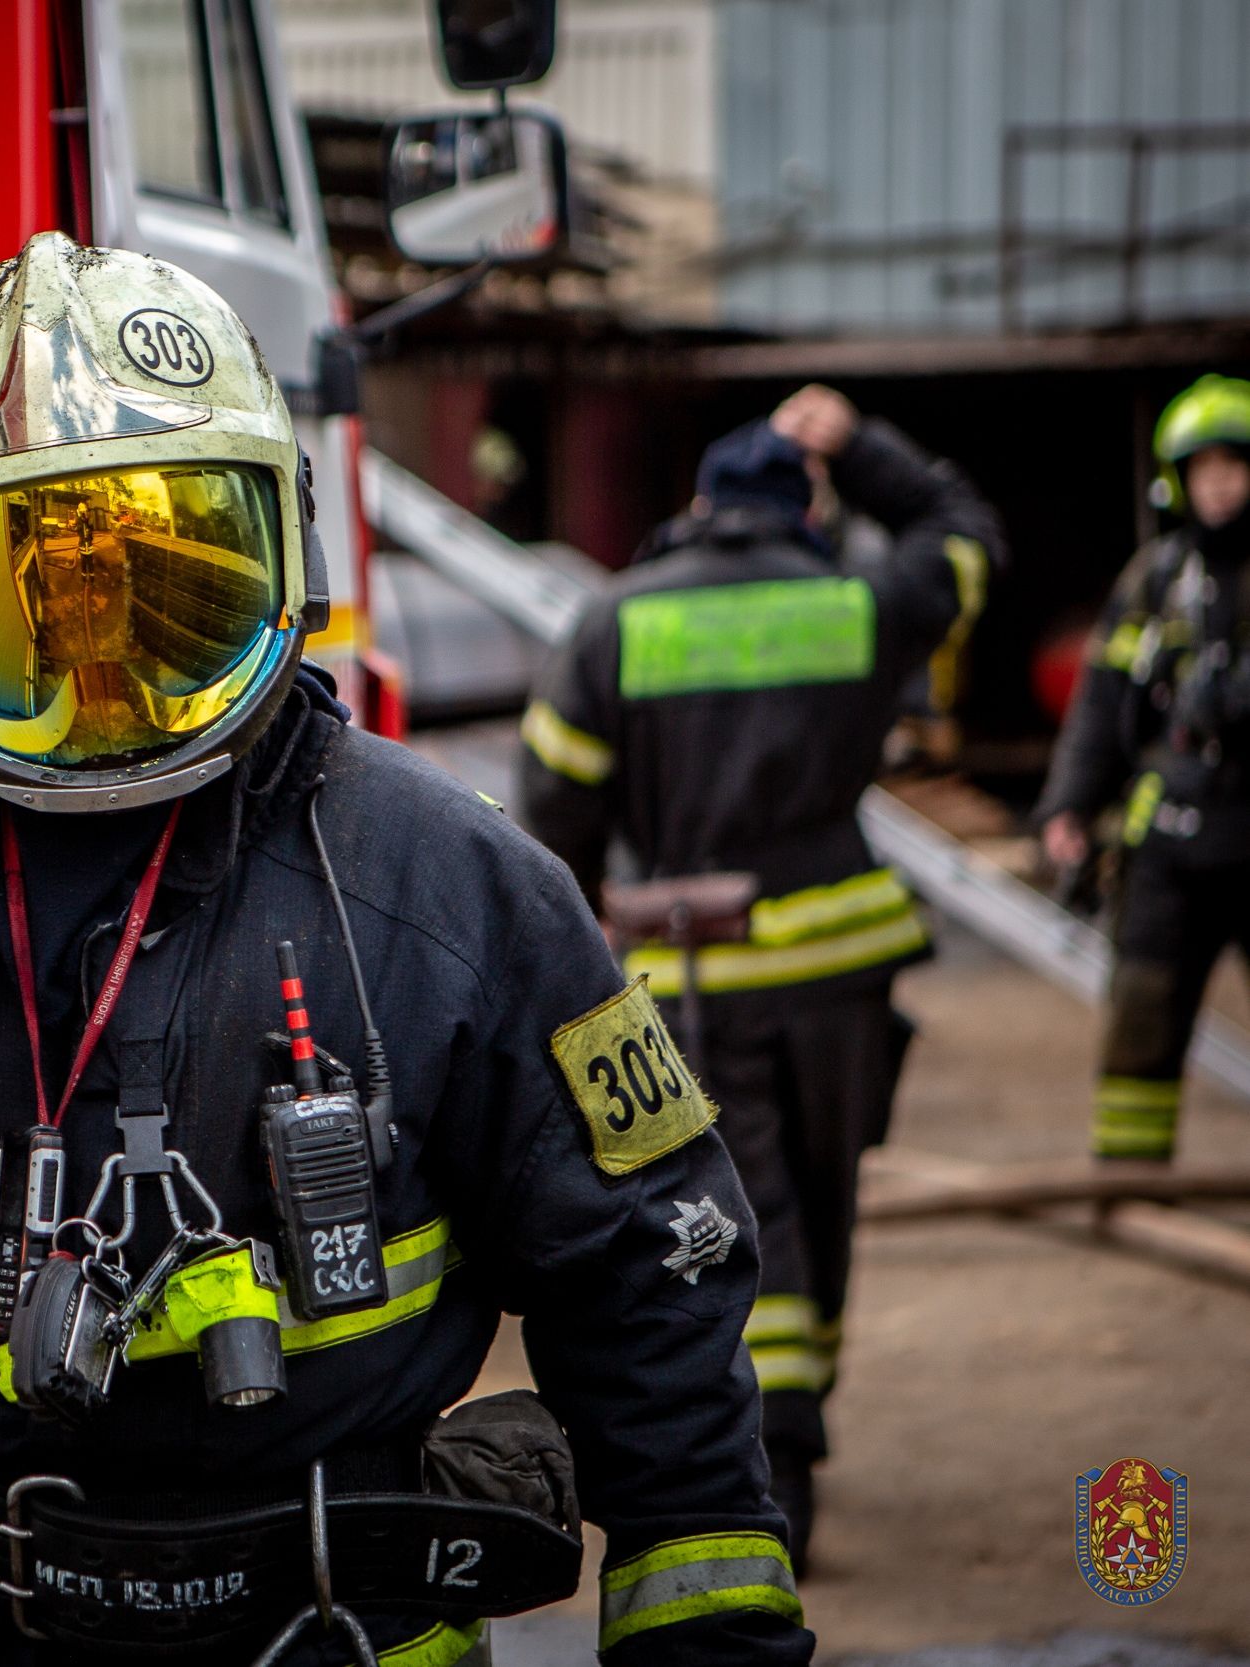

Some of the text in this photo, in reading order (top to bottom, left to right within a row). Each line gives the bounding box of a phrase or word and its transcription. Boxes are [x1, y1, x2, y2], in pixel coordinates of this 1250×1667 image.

[131, 319, 204, 375] 303
[93, 929, 138, 1026] MITSUBISHI MOTORS
[310, 1223, 368, 1262] 217
[425, 1537, 483, 1588] 12
